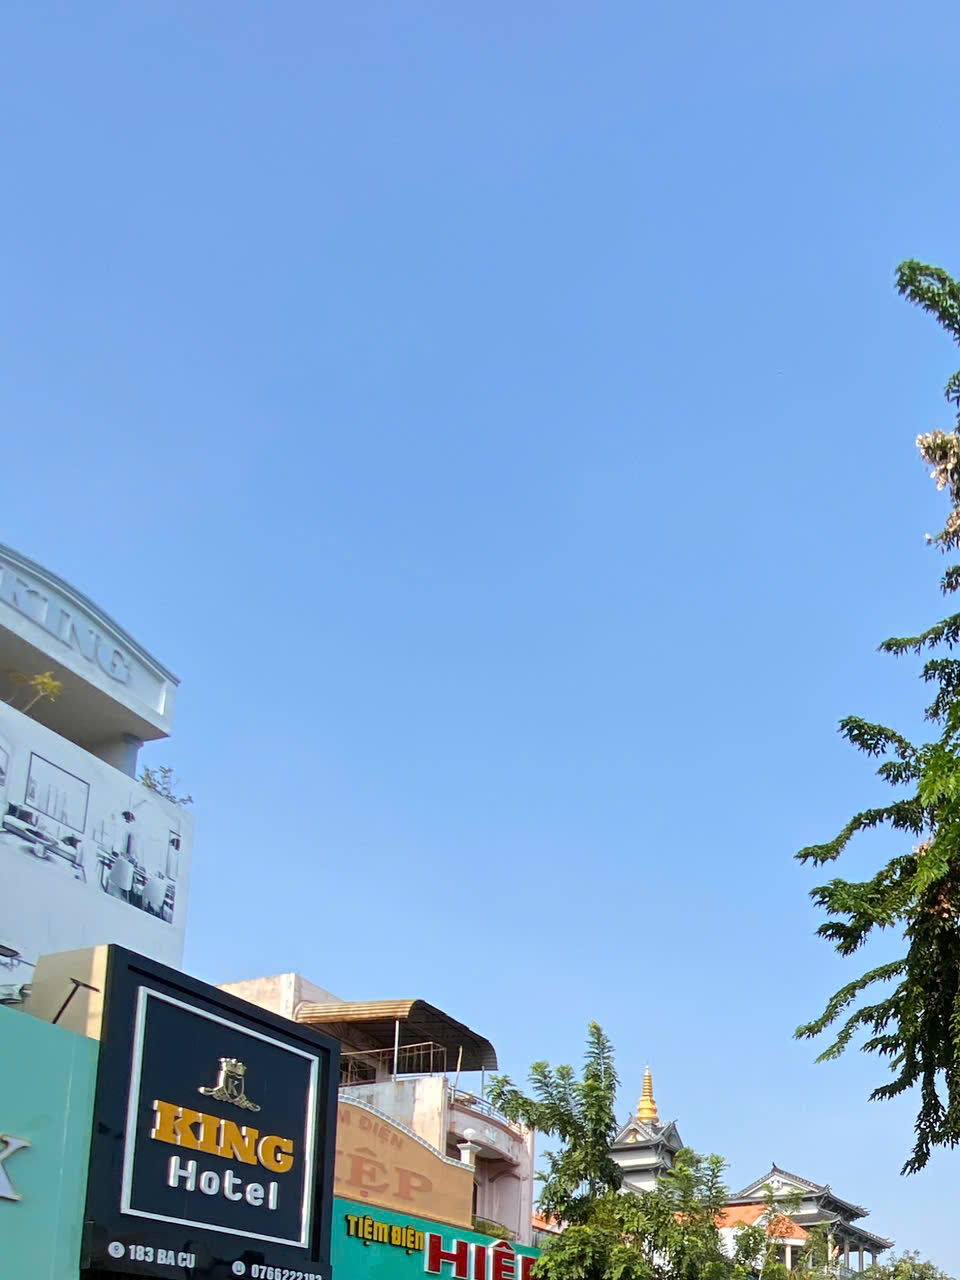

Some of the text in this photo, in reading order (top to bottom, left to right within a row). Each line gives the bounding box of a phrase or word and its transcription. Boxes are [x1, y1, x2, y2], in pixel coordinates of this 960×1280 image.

[151, 1099, 294, 1174] KING
[168, 1156, 278, 1210] Hotel
[129, 1244, 196, 1268] 183 BA CU
[346, 1214, 389, 1247] TIỆM
[390, 1224, 425, 1256] ĐIỆN
